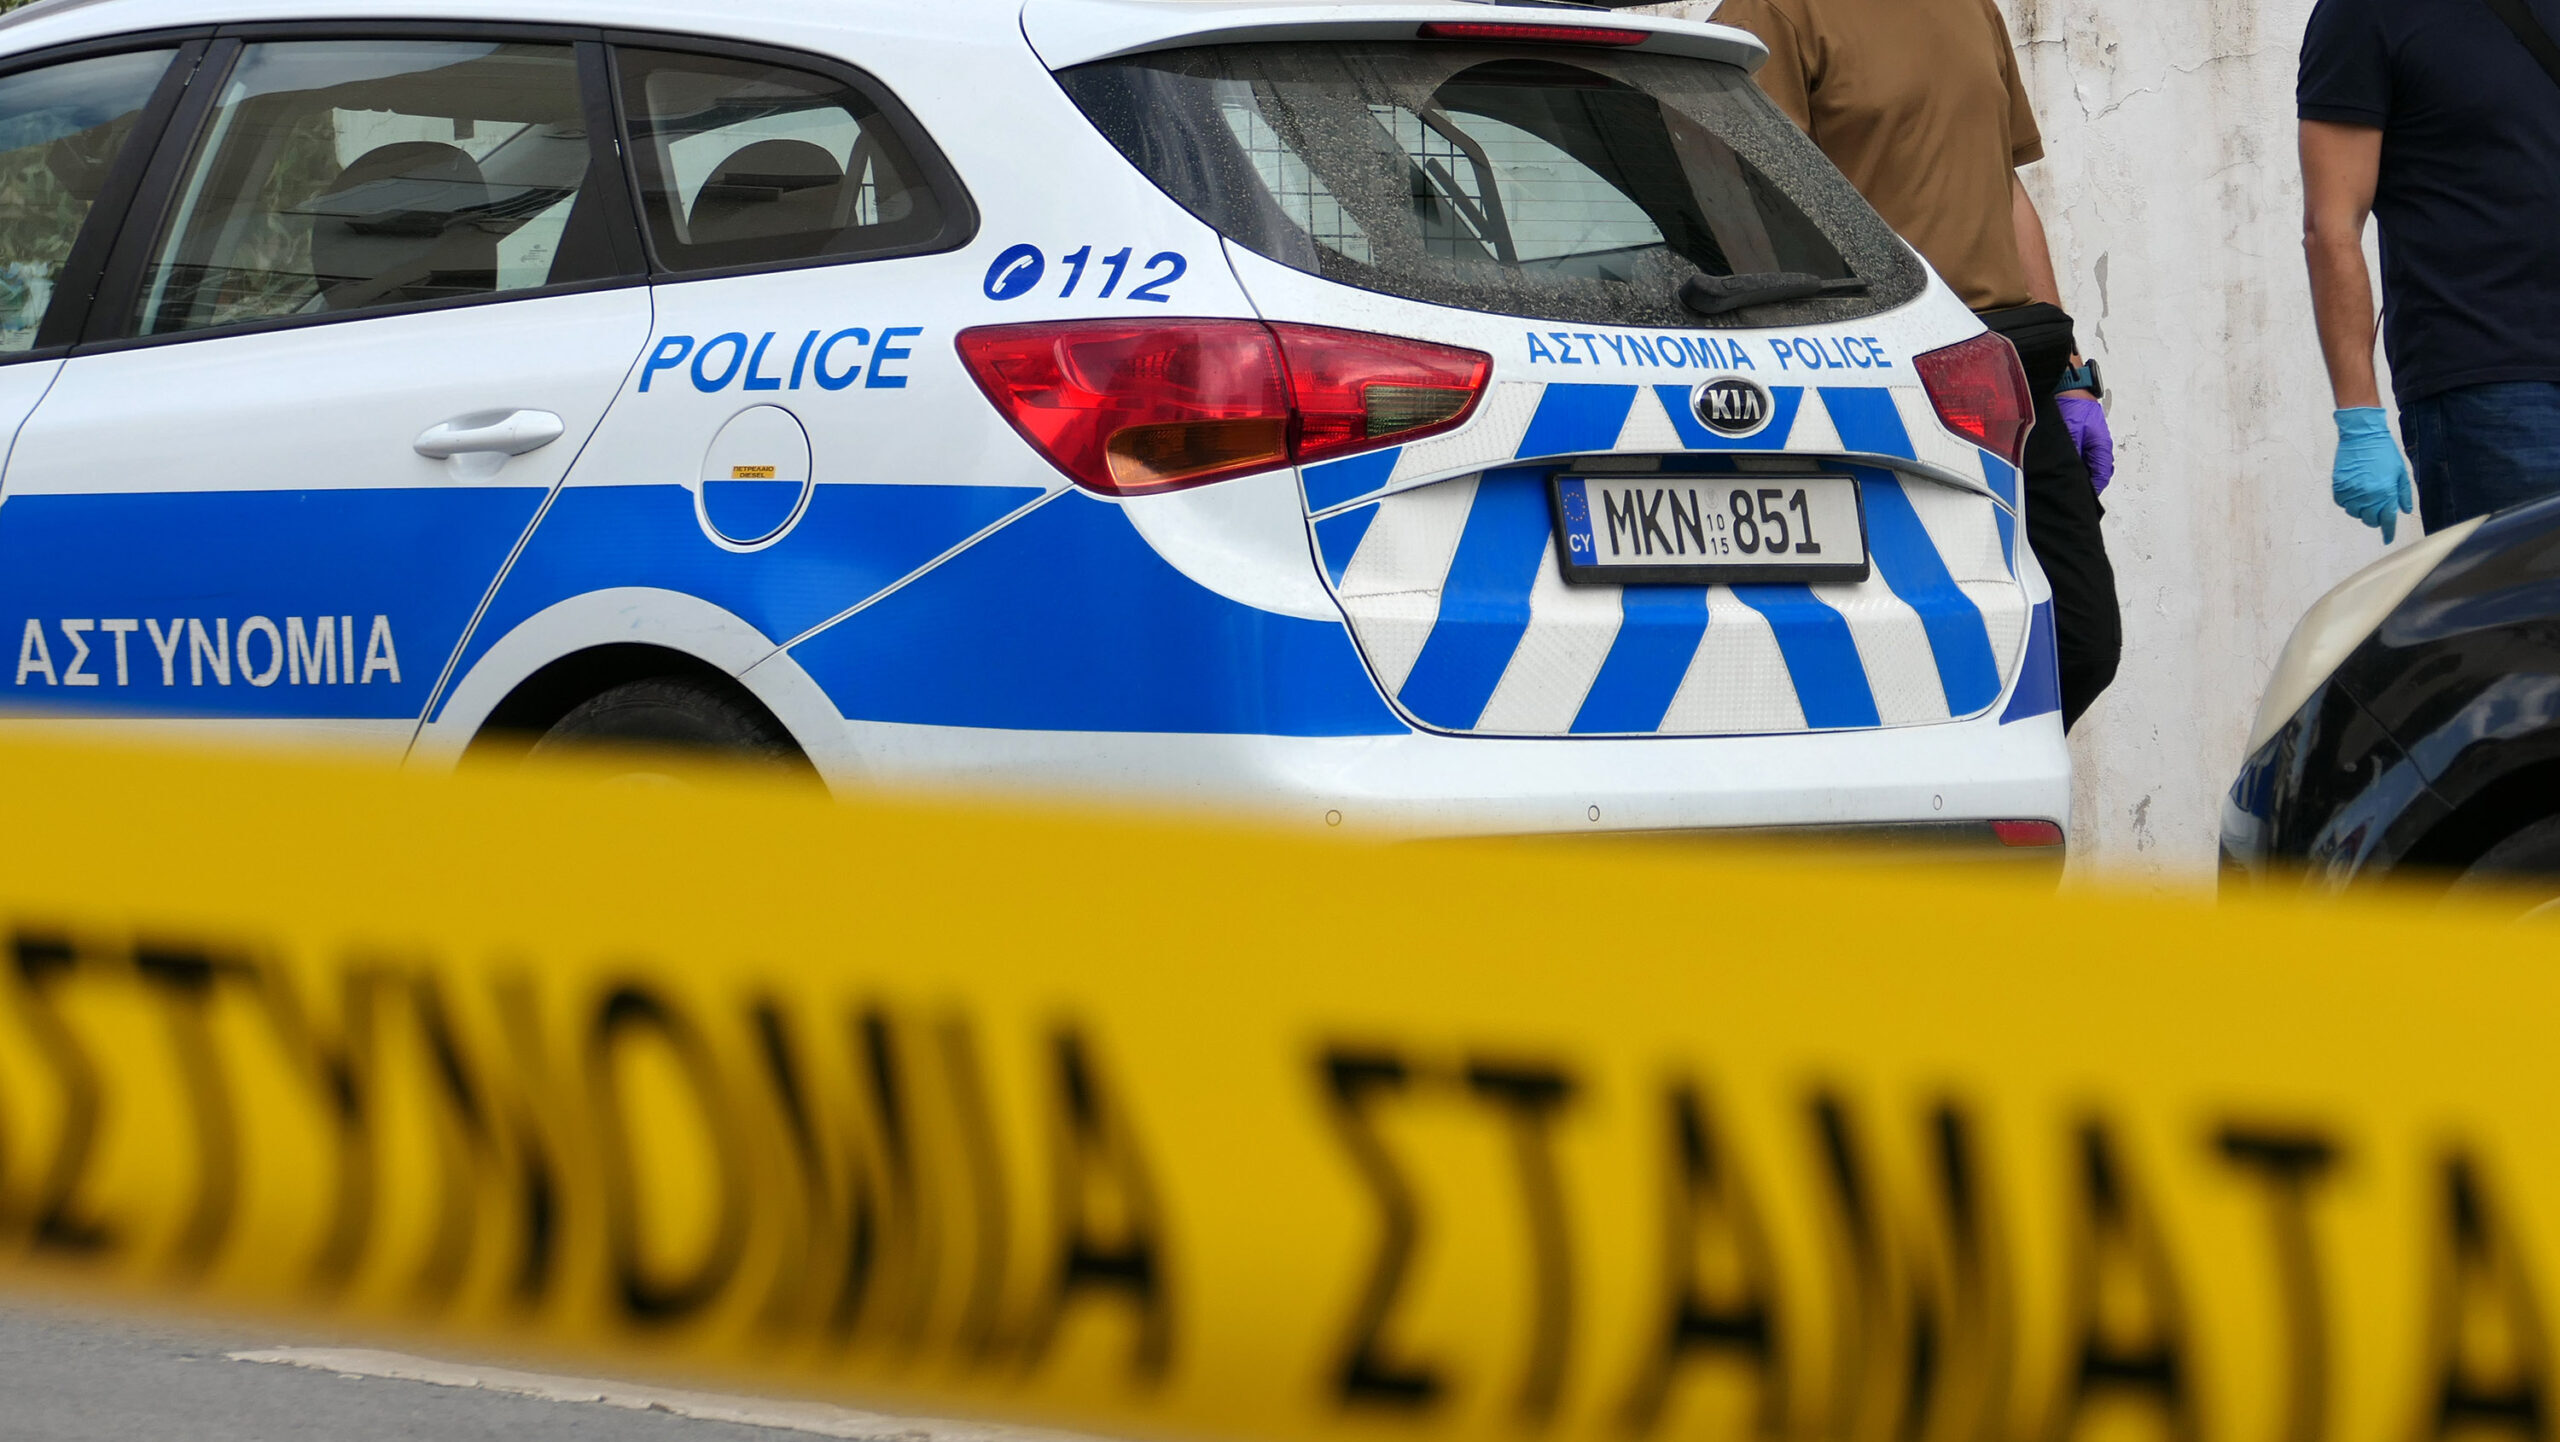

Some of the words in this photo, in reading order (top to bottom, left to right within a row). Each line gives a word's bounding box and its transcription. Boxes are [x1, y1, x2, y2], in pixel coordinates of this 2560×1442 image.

[1058, 245, 1188, 303] 112
[638, 326, 924, 393] POLICE
[1526, 331, 1756, 371] ΑΣΤΥΝΟΜΙΑ
[1768, 336, 1893, 371] POLICE
[1708, 388, 1761, 420] KIA
[1569, 532, 1591, 553] CY
[1603, 488, 1706, 555] MKN
[1729, 488, 1821, 555] 851
[1706, 513, 1725, 531] 10
[1710, 536, 1730, 556] 15
[15, 615, 402, 688] ΑΣΤΥΝΟΜΙΑ
[0, 925, 1190, 1392] ΣΤΥΝΟΜΙΑ
